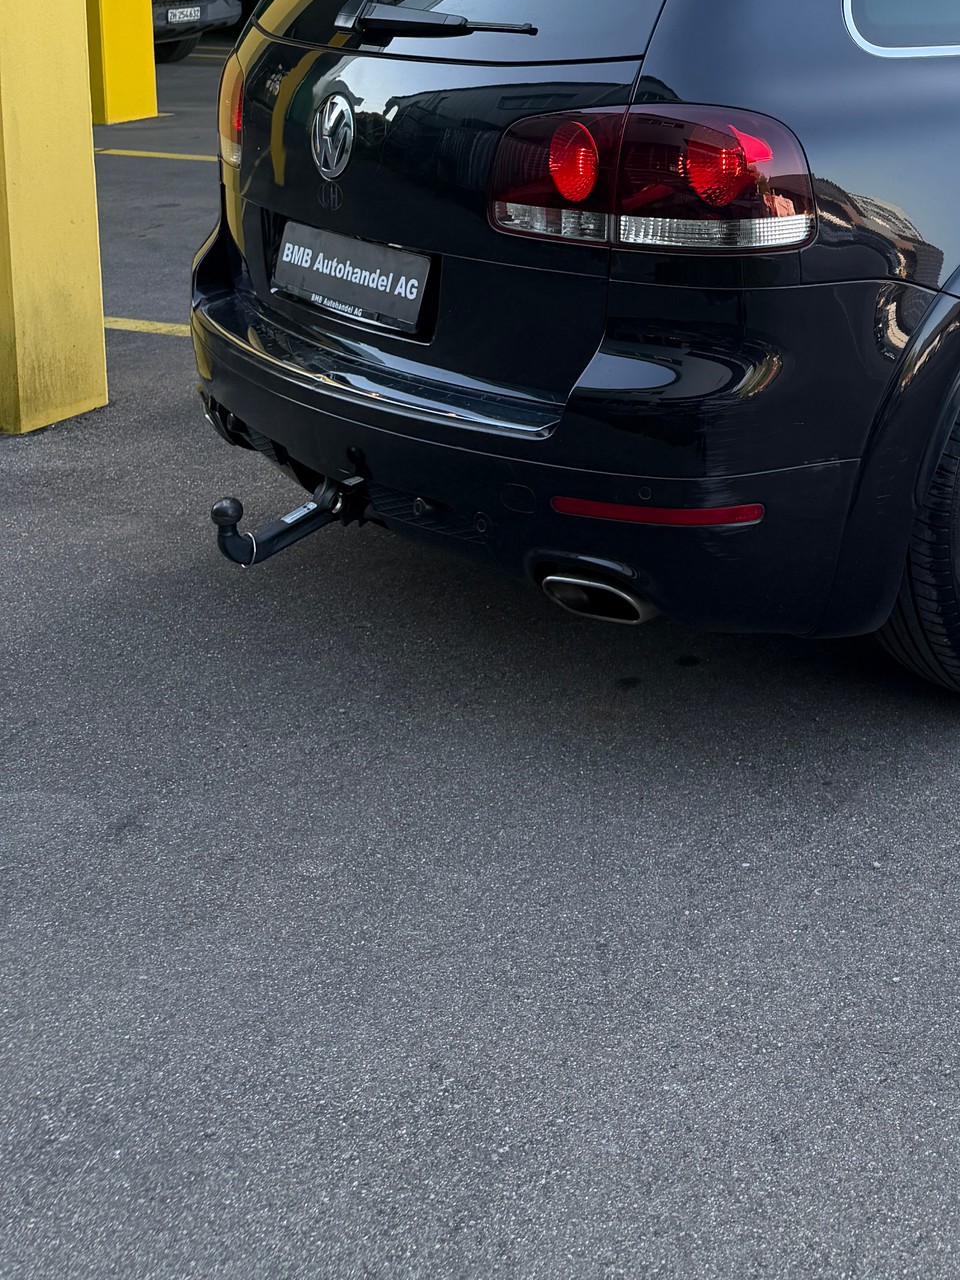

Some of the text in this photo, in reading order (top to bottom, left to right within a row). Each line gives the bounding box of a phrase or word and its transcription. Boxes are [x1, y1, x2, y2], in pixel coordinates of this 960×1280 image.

[282, 242, 418, 300] BMB Autohandel AG
[311, 293, 363, 317] BMB Autohandel AG
